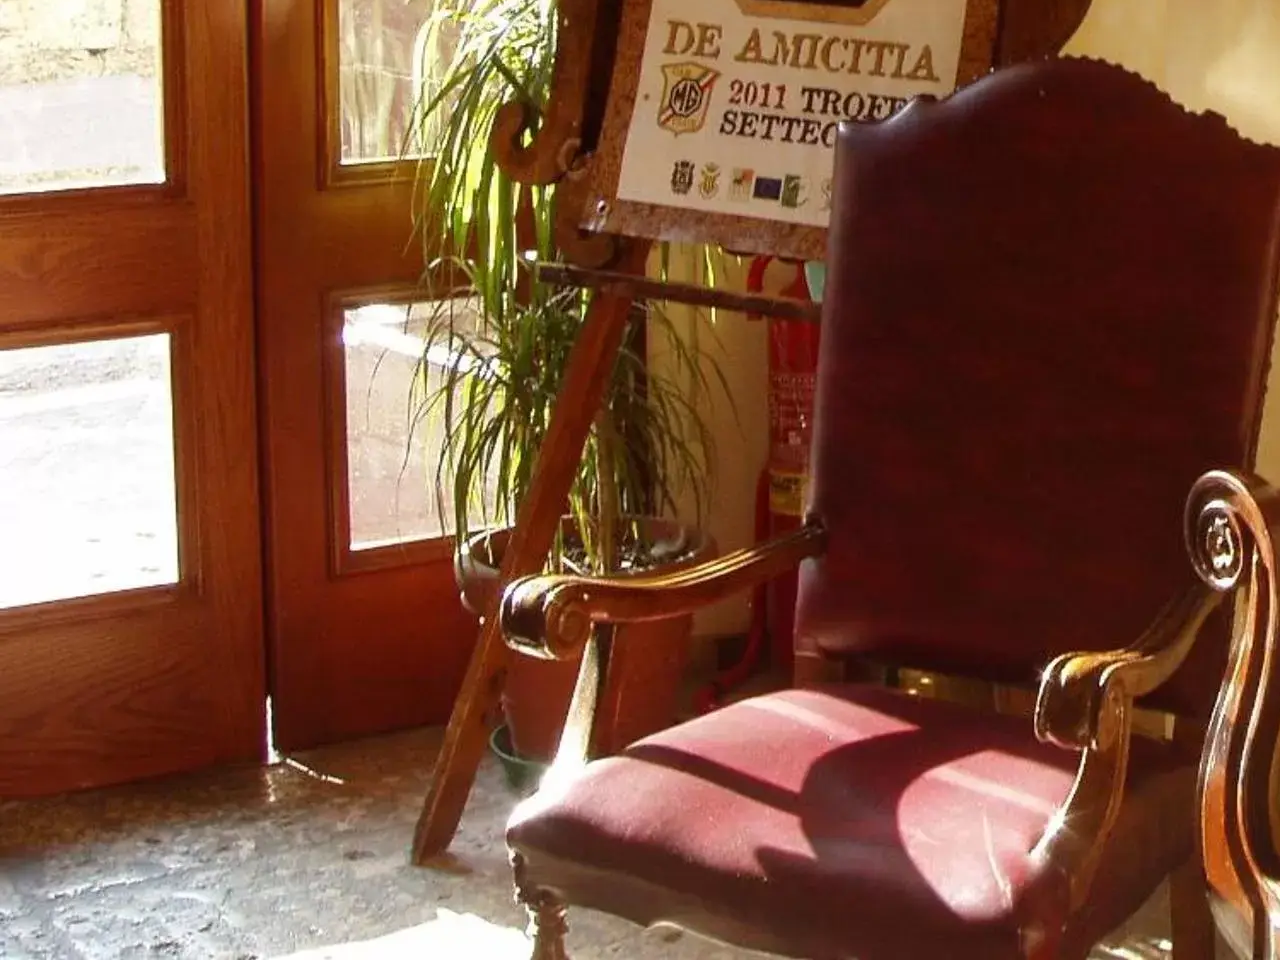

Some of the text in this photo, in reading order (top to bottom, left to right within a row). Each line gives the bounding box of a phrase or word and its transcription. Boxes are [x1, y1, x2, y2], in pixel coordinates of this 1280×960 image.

[662, 20, 940, 83] DE AMICITIA
[672, 81, 701, 114] MG
[728, 79, 787, 110] 2011
